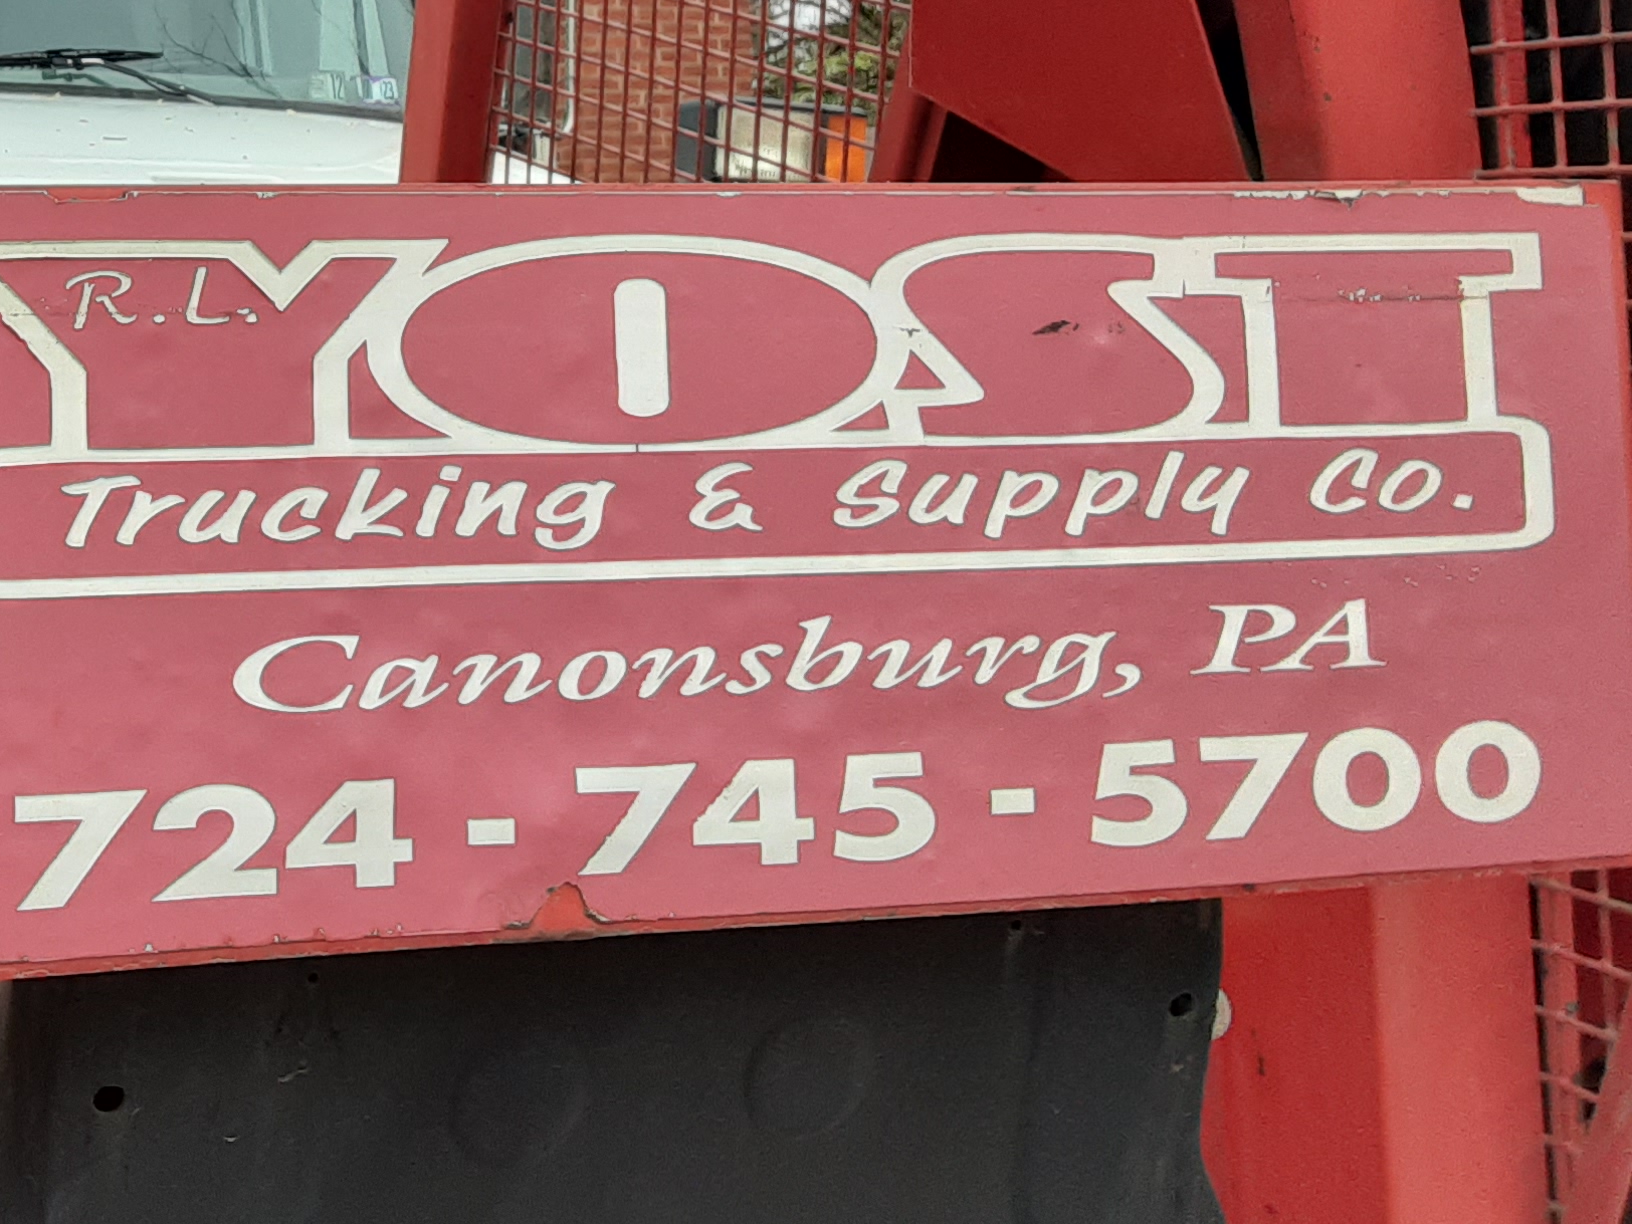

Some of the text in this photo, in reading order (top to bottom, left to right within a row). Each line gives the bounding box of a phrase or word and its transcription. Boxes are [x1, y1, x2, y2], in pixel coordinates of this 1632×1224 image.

[64, 266, 259, 331] R.L.
[60, 447, 1474, 550] Trucking & Supply Co.
[232, 598, 1387, 714] Canonsburg, PA
